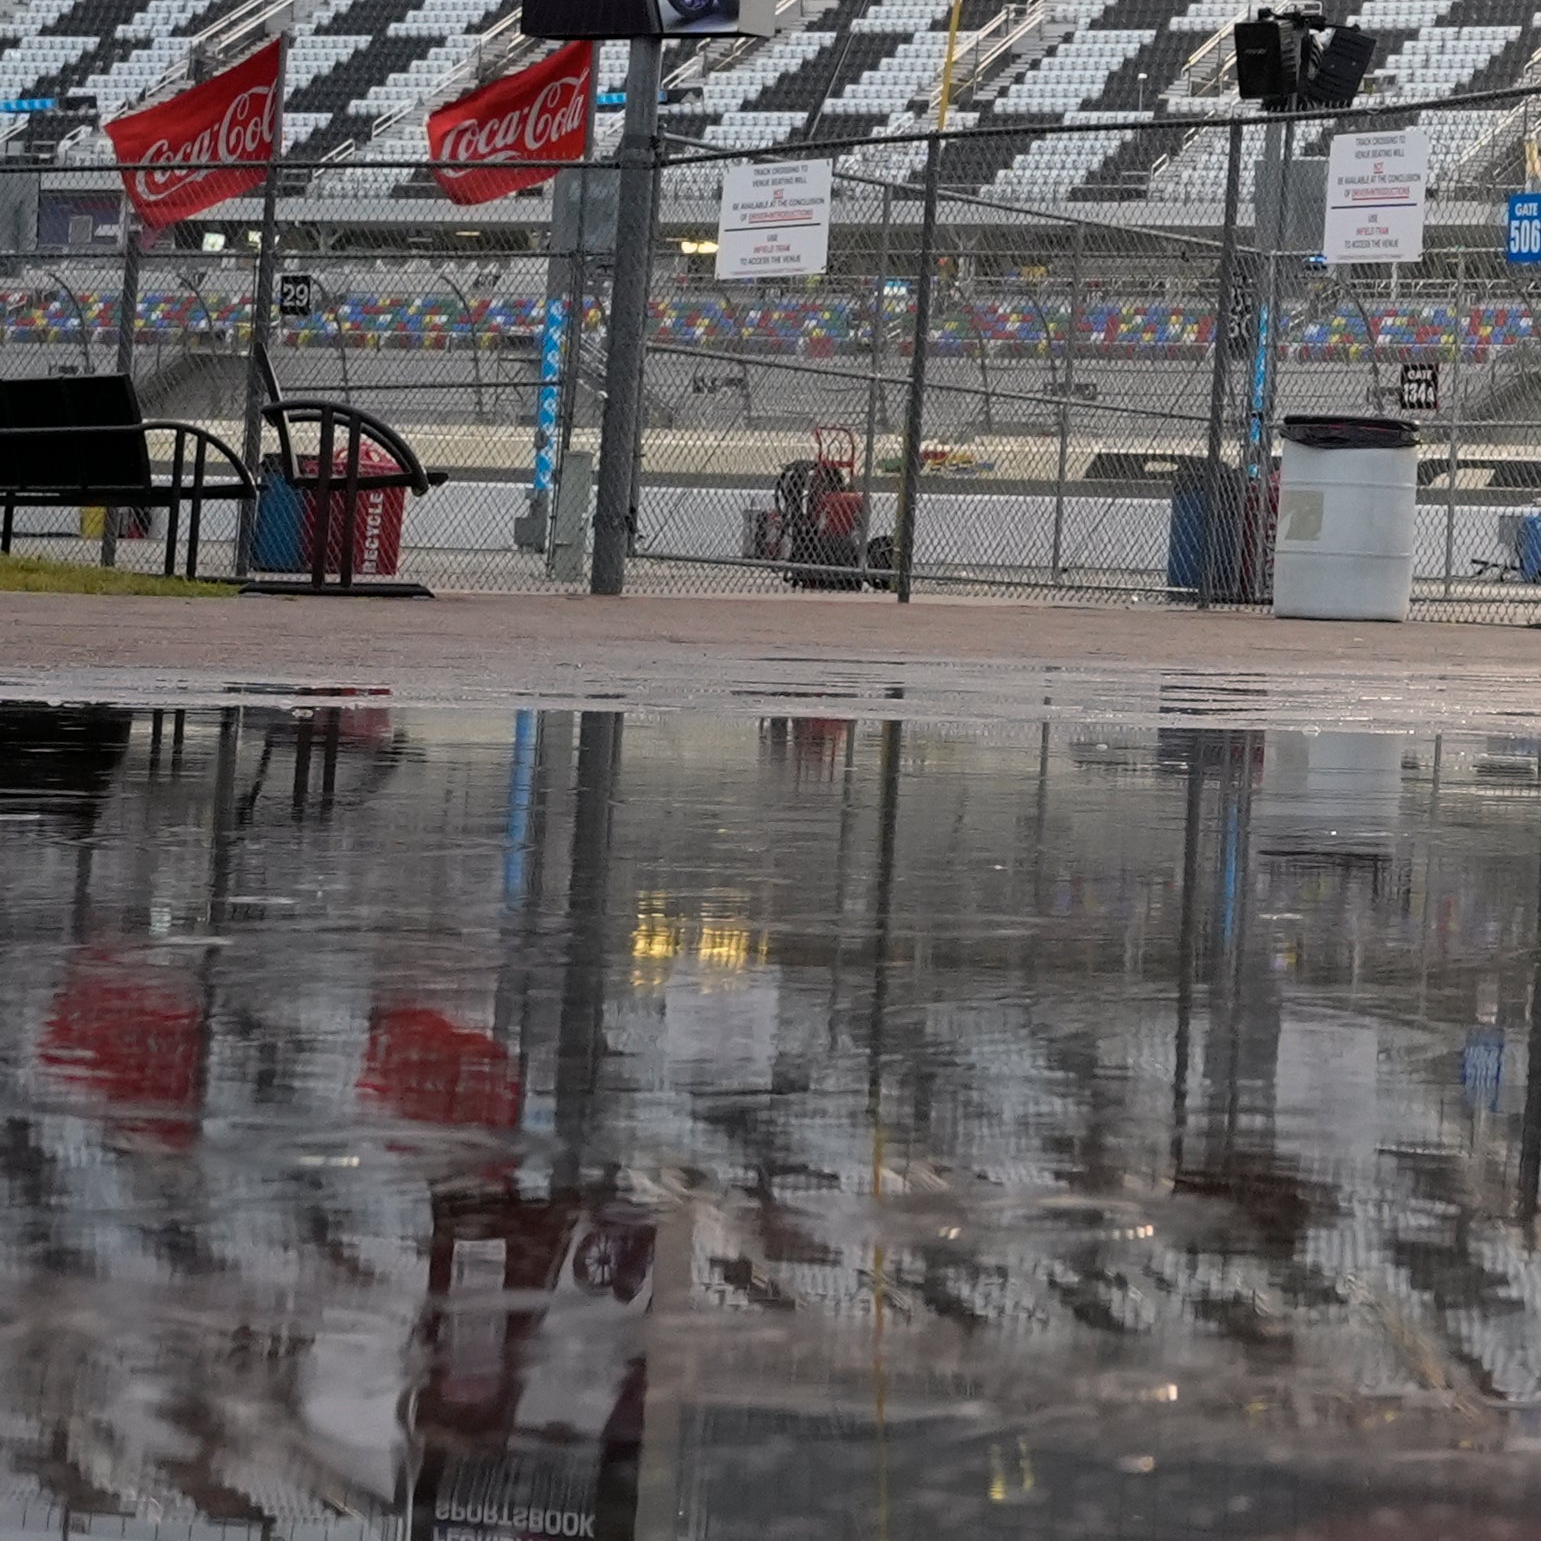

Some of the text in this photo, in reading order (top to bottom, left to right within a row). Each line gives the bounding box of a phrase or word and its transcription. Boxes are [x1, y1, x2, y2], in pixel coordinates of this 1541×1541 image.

[440, 67, 590, 177] Coca-Cola
[136, 79, 277, 201] Coca-Col
[1515, 202, 1539, 217] GATE
[1510, 219, 1541, 254] 506
[282, 283, 309, 307] 29
